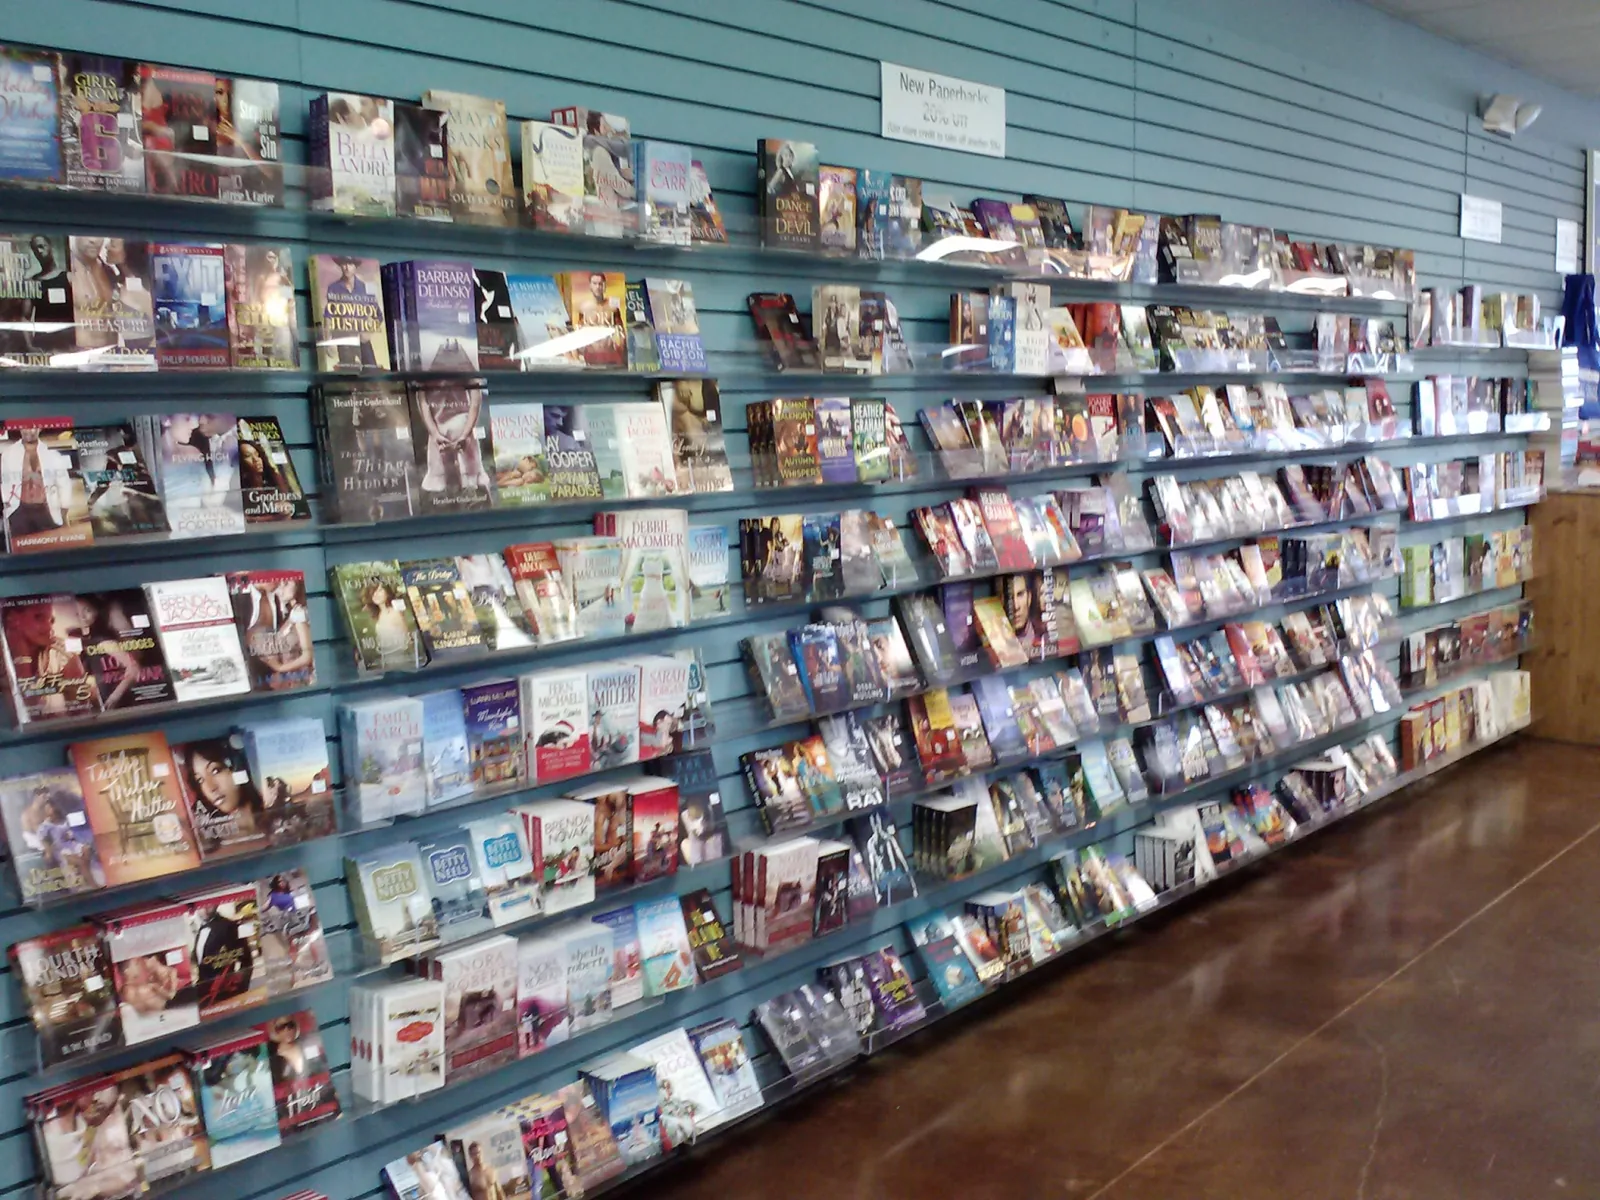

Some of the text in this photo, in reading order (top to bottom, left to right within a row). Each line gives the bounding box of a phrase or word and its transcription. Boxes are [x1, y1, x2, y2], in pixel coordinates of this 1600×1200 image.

[74, 72, 117, 88] GIRLS
[900, 72, 925, 95] New
[76, 85, 121, 102] FROM
[448, 108, 496, 128] MAYA
[80, 112, 124, 173] 6
[259, 134, 278, 160] Sin
[337, 132, 388, 160] BELLA
[339, 158, 392, 176] ANDRE
[651, 158, 687, 174] ROBYN
[651, 174, 687, 191] CARR
[776, 198, 813, 214] DANCE
[776, 218, 816, 236] DEVIL
[154, 255, 223, 297] EXIT
[417, 269, 471, 286] BARBARA
[418, 283, 472, 299] DELINSKY
[327, 302, 378, 319] COWBOY
[80, 317, 148, 333] PLEASURE
[329, 316, 381, 333] JUSTICE
[659, 338, 703, 351] RACHEL
[662, 349, 704, 361] GIBSON
[332, 398, 363, 408] Heather
[853, 403, 884, 419] HEATHER
[854, 417, 885, 434] GRAHAM
[354, 459, 411, 477] Things
[249, 489, 303, 503] Goodness
[550, 484, 602, 497] PARADISE
[245, 501, 296, 517] and Mercy
[632, 519, 670, 534] DEBBIE
[16, 535, 59, 547] HARMONY
[622, 532, 684, 549] MACOMBER
[160, 593, 217, 610] BRENDA
[164, 603, 229, 622] JACKSON
[650, 668, 687, 685] SARAH
[76, 685, 92, 700] 5
[548, 681, 574, 696] FERN
[595, 687, 636, 708] MILLER
[365, 723, 419, 742] MARCH
[544, 813, 592, 835] BRENDA
[548, 825, 589, 846] NOVAK
[459, 952, 505, 971] NORA
[570, 944, 606, 962] sheila
[567, 954, 609, 974] roberts
